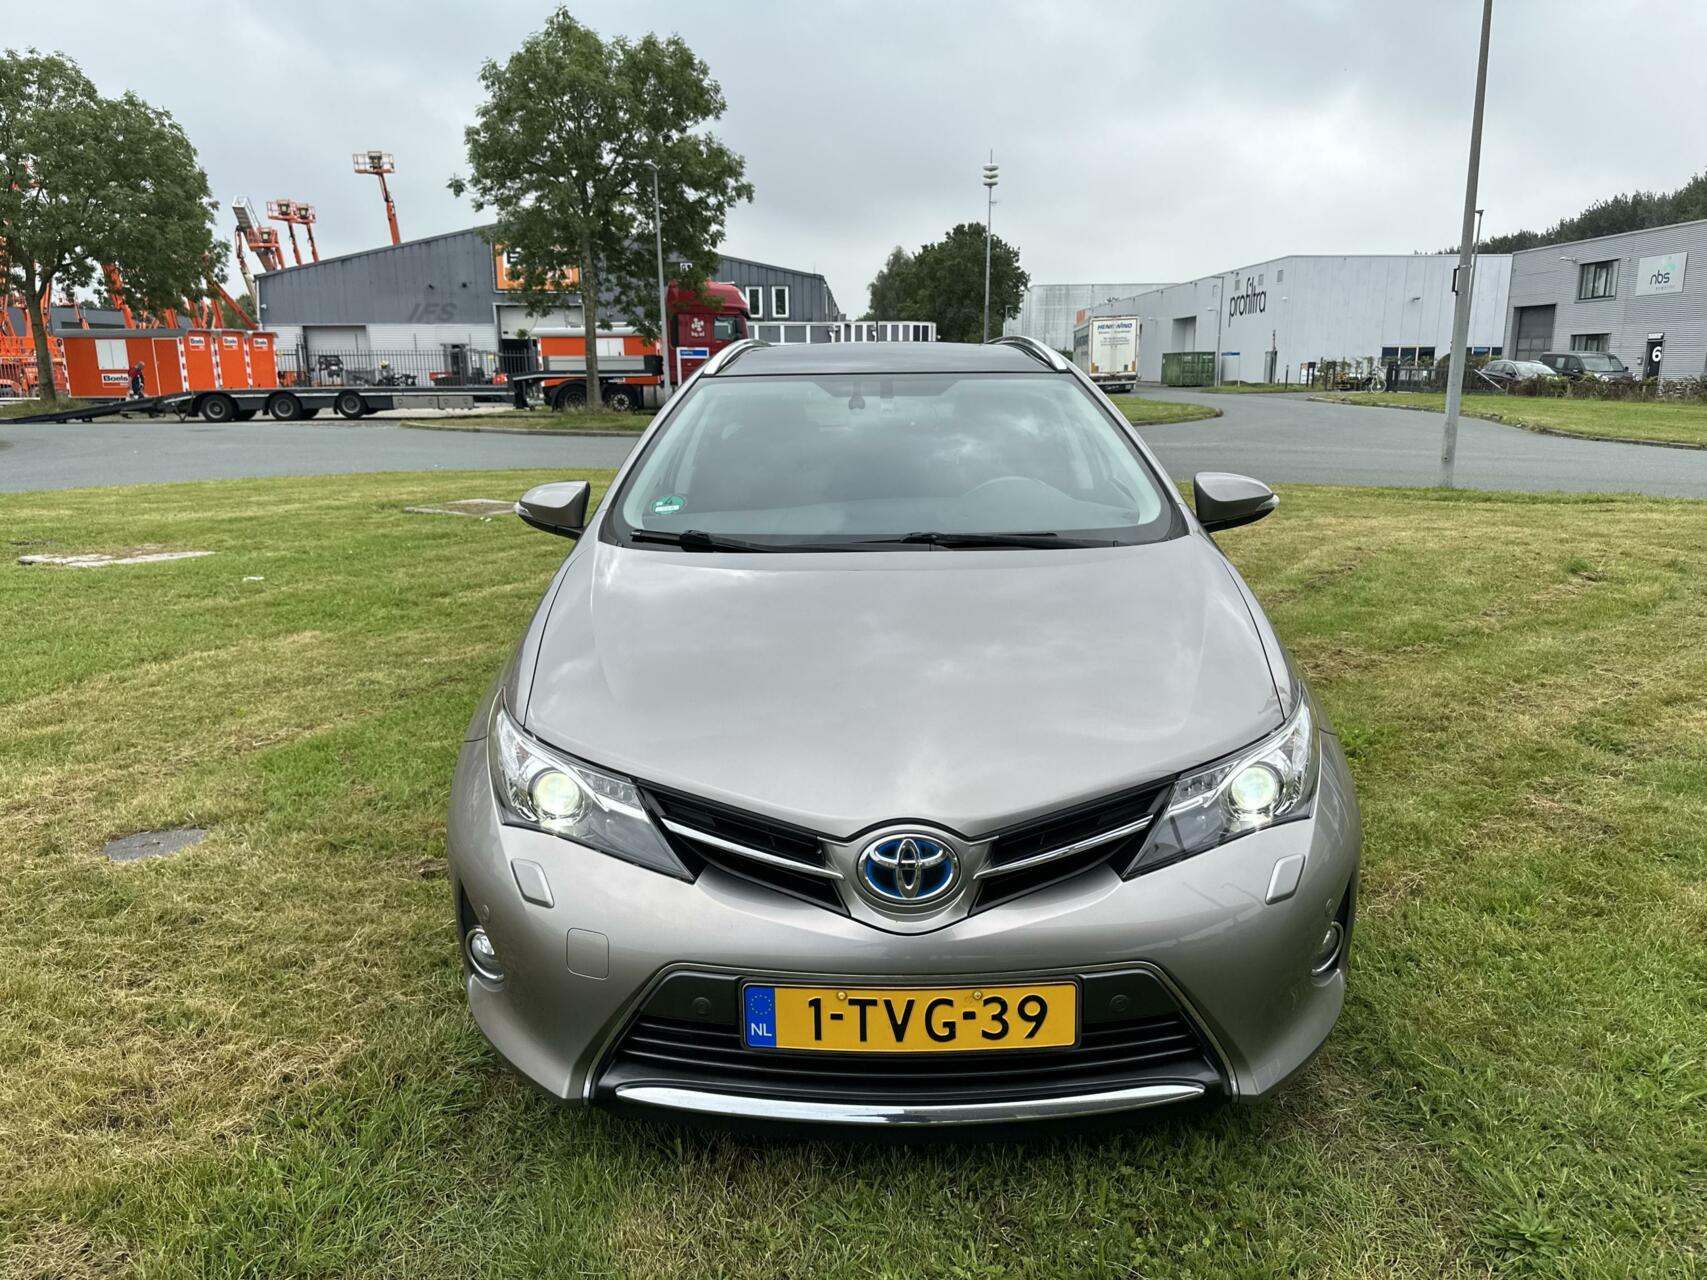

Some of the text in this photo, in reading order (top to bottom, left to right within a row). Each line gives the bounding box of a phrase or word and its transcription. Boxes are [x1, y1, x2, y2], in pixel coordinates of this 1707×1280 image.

[1650, 269, 1670, 285] nbs
[1228, 276, 1267, 328] profiltra
[408, 302, 457, 322] IFS
[1652, 346, 1662, 362] 6
[808, 994, 1049, 1043] 1-TVG-39
[750, 1022, 772, 1037] NL
